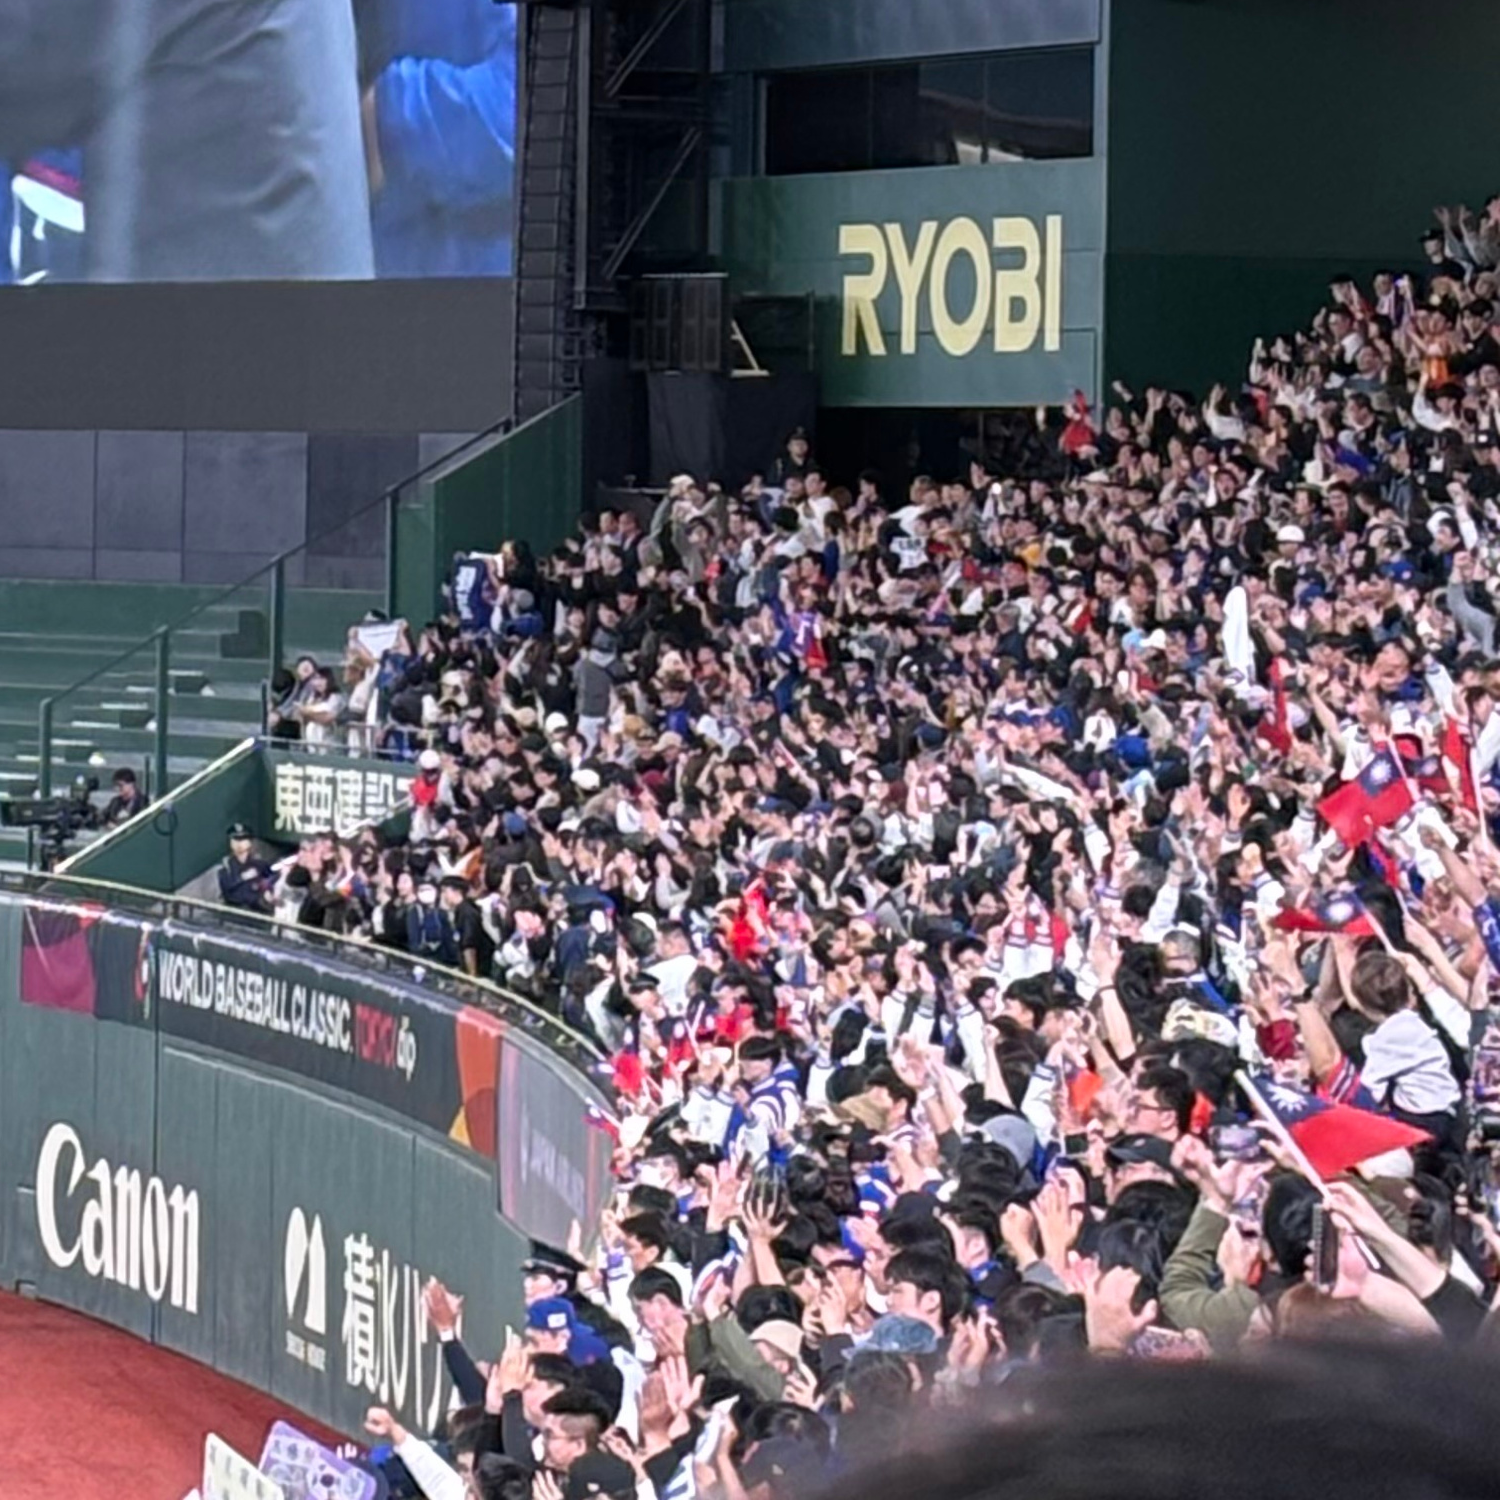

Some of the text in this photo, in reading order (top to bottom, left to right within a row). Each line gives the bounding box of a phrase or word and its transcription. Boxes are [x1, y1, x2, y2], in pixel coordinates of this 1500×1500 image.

[839, 214, 1062, 357] RYOBI
[275, 762, 417, 838] 東亜建設
[159, 949, 213, 1010] WORLD
[214, 963, 290, 1033] BASEBALL
[36, 1122, 198, 1315] Canon
